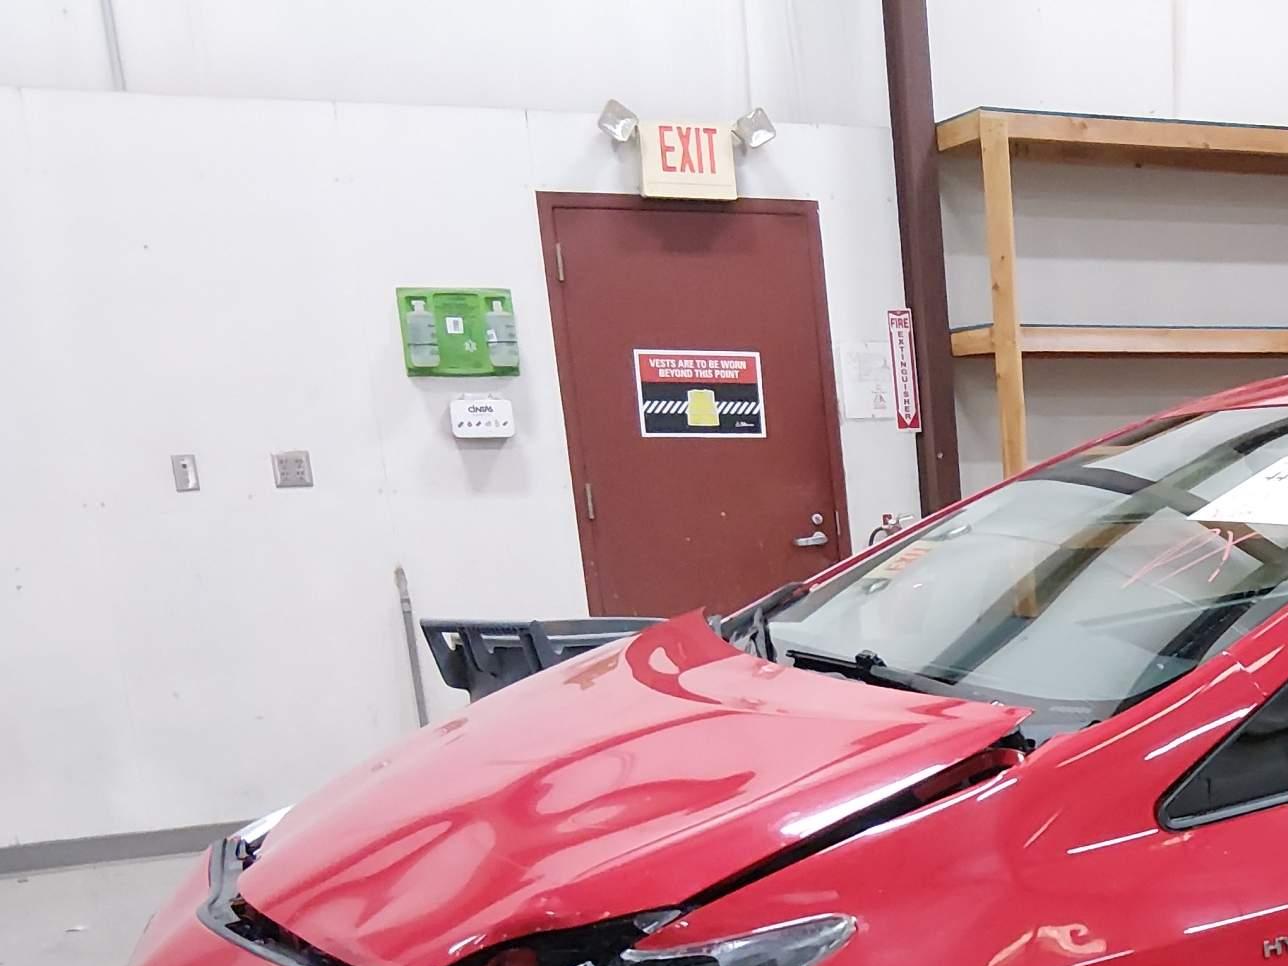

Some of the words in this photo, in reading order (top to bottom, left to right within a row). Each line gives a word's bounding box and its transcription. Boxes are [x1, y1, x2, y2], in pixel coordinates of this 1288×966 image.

[658, 126, 717, 174] EXIT
[890, 318, 909, 328] FIRE
[649, 358, 676, 369] VESTS
[677, 359, 695, 369] ARE
[695, 360, 707, 369] TO
[708, 360, 721, 369] BE
[721, 360, 747, 370] WORN
[658, 369, 693, 378] BEYOND
[695, 369, 713, 378] THIS
[715, 369, 740, 379] POINT
[897, 331, 912, 419] EXTINGUISHER
